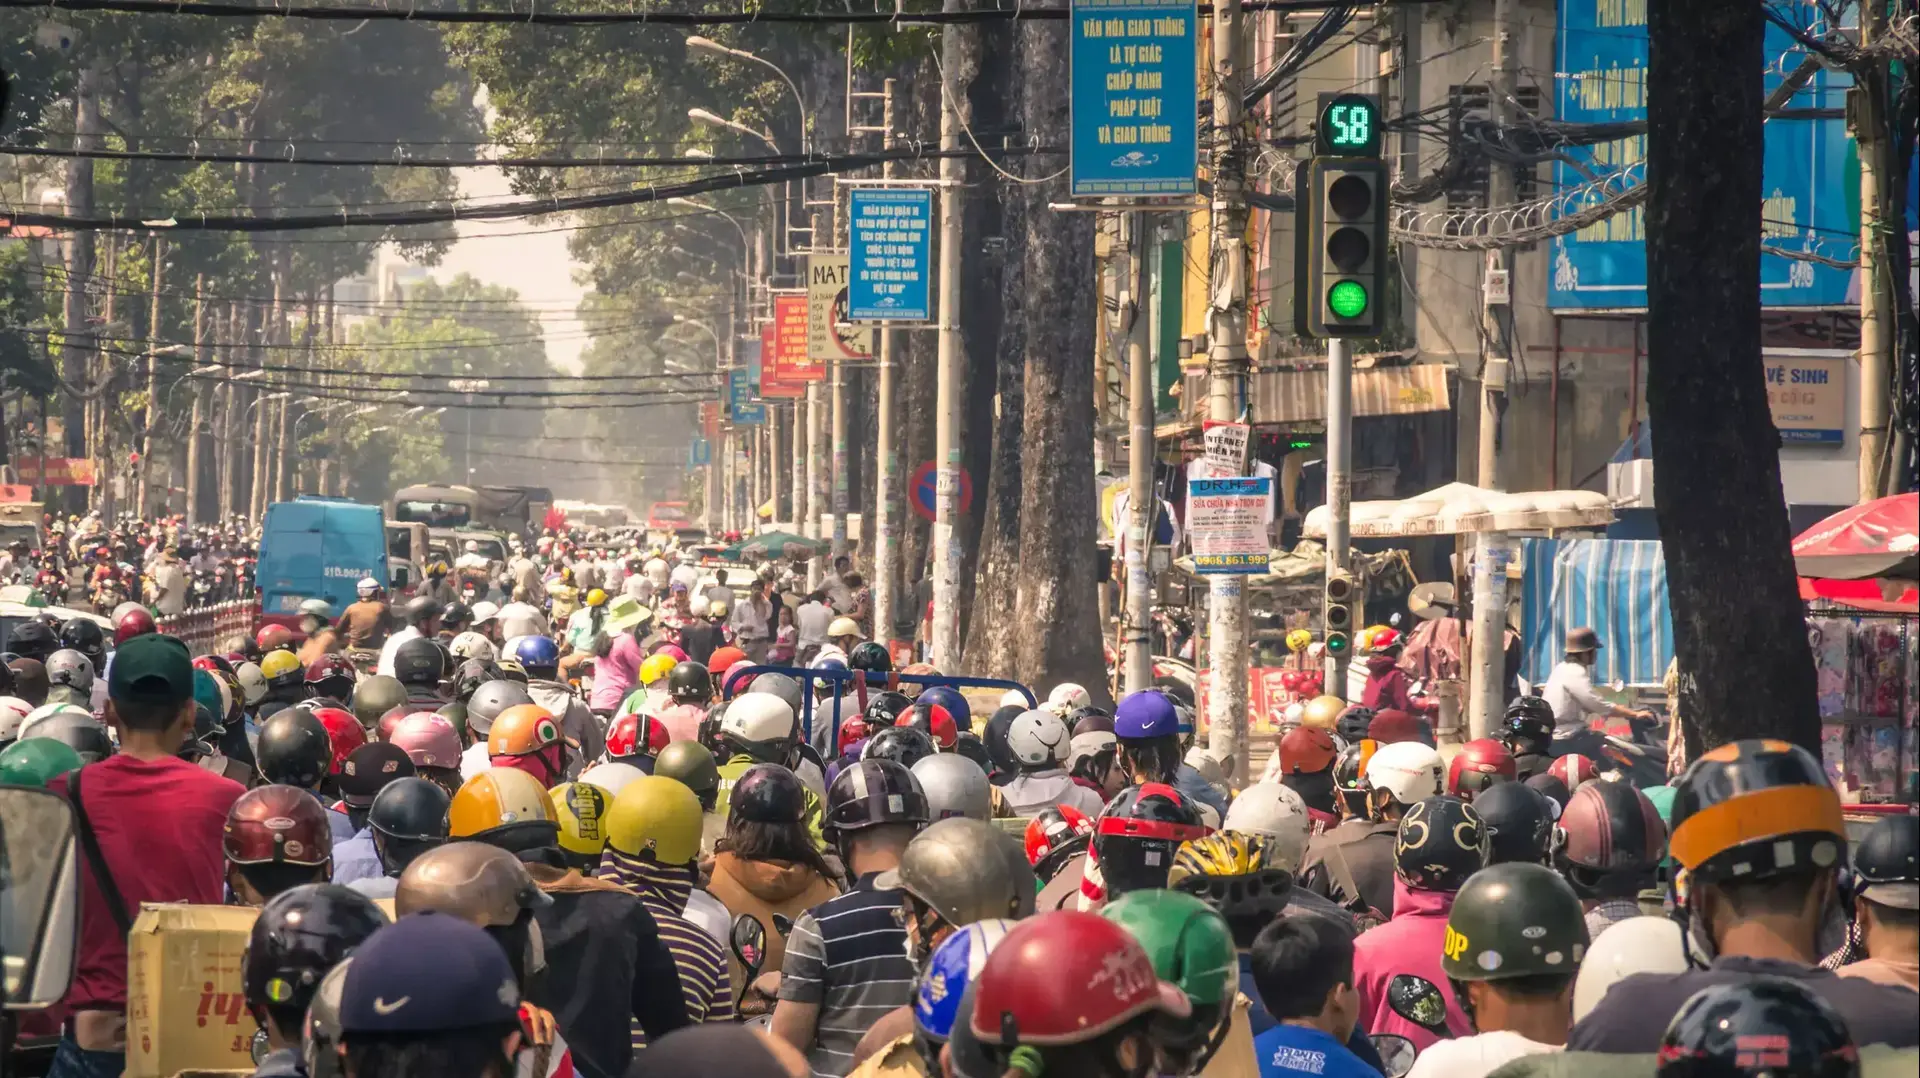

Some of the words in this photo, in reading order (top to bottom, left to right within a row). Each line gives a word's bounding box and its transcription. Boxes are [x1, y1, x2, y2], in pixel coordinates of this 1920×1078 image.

[1083, 18, 1102, 37] VĂN
[1105, 17, 1125, 37] HÓA
[1128, 20, 1151, 37] GIAO
[1153, 16, 1185, 36] THÔNG
[1109, 44, 1121, 64] LÀ
[1124, 44, 1137, 67] TỰ
[1138, 43, 1162, 63] GIÁC
[1106, 69, 1133, 90] CHẤP
[1135, 70, 1162, 90] HÀNH
[1110, 97, 1136, 117] PHÁP
[1139, 96, 1162, 120] LUẬT
[1098, 124, 1111, 144] VÀ
[1113, 125, 1137, 144] GIAO
[1139, 123, 1172, 144] THÔNG
[1331, 105, 1368, 144] 58
[1790, 368, 1829, 385] SINH
[1205, 435, 1245, 448] INTERNET
